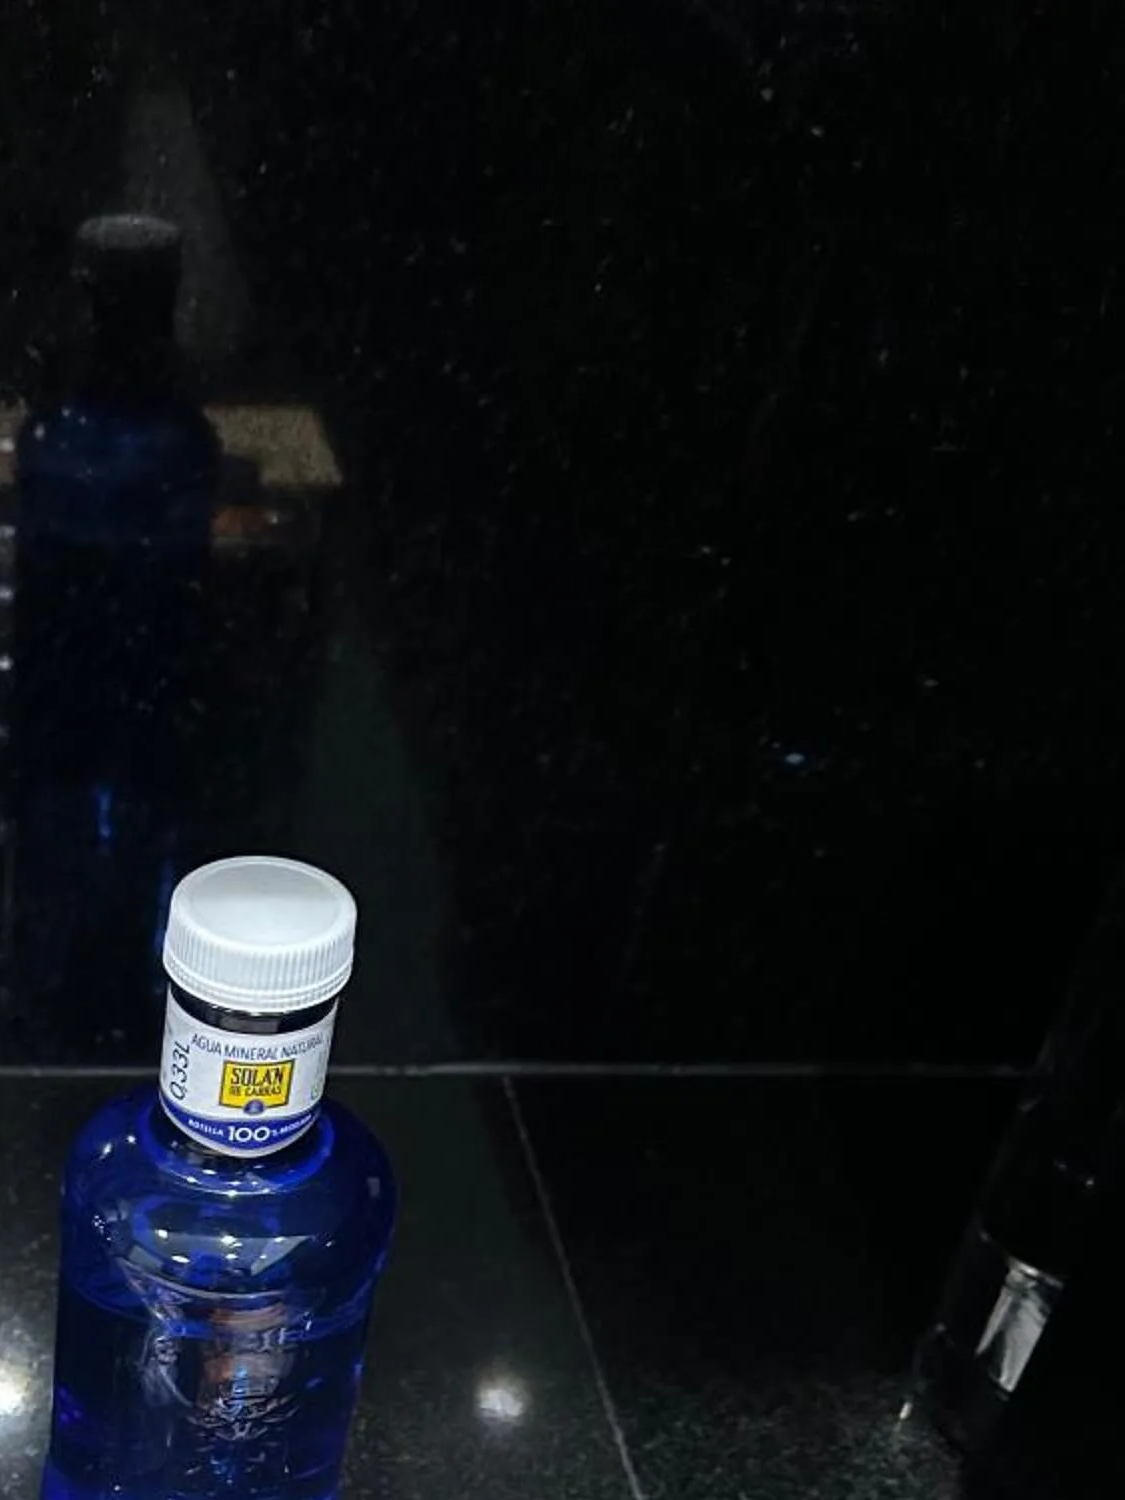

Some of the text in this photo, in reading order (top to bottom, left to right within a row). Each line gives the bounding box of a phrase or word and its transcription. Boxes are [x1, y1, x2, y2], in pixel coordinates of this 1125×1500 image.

[191, 1033, 222, 1056] AGUA
[224, 1045, 277, 1061] MINERAL
[228, 1126, 270, 1142] 100
